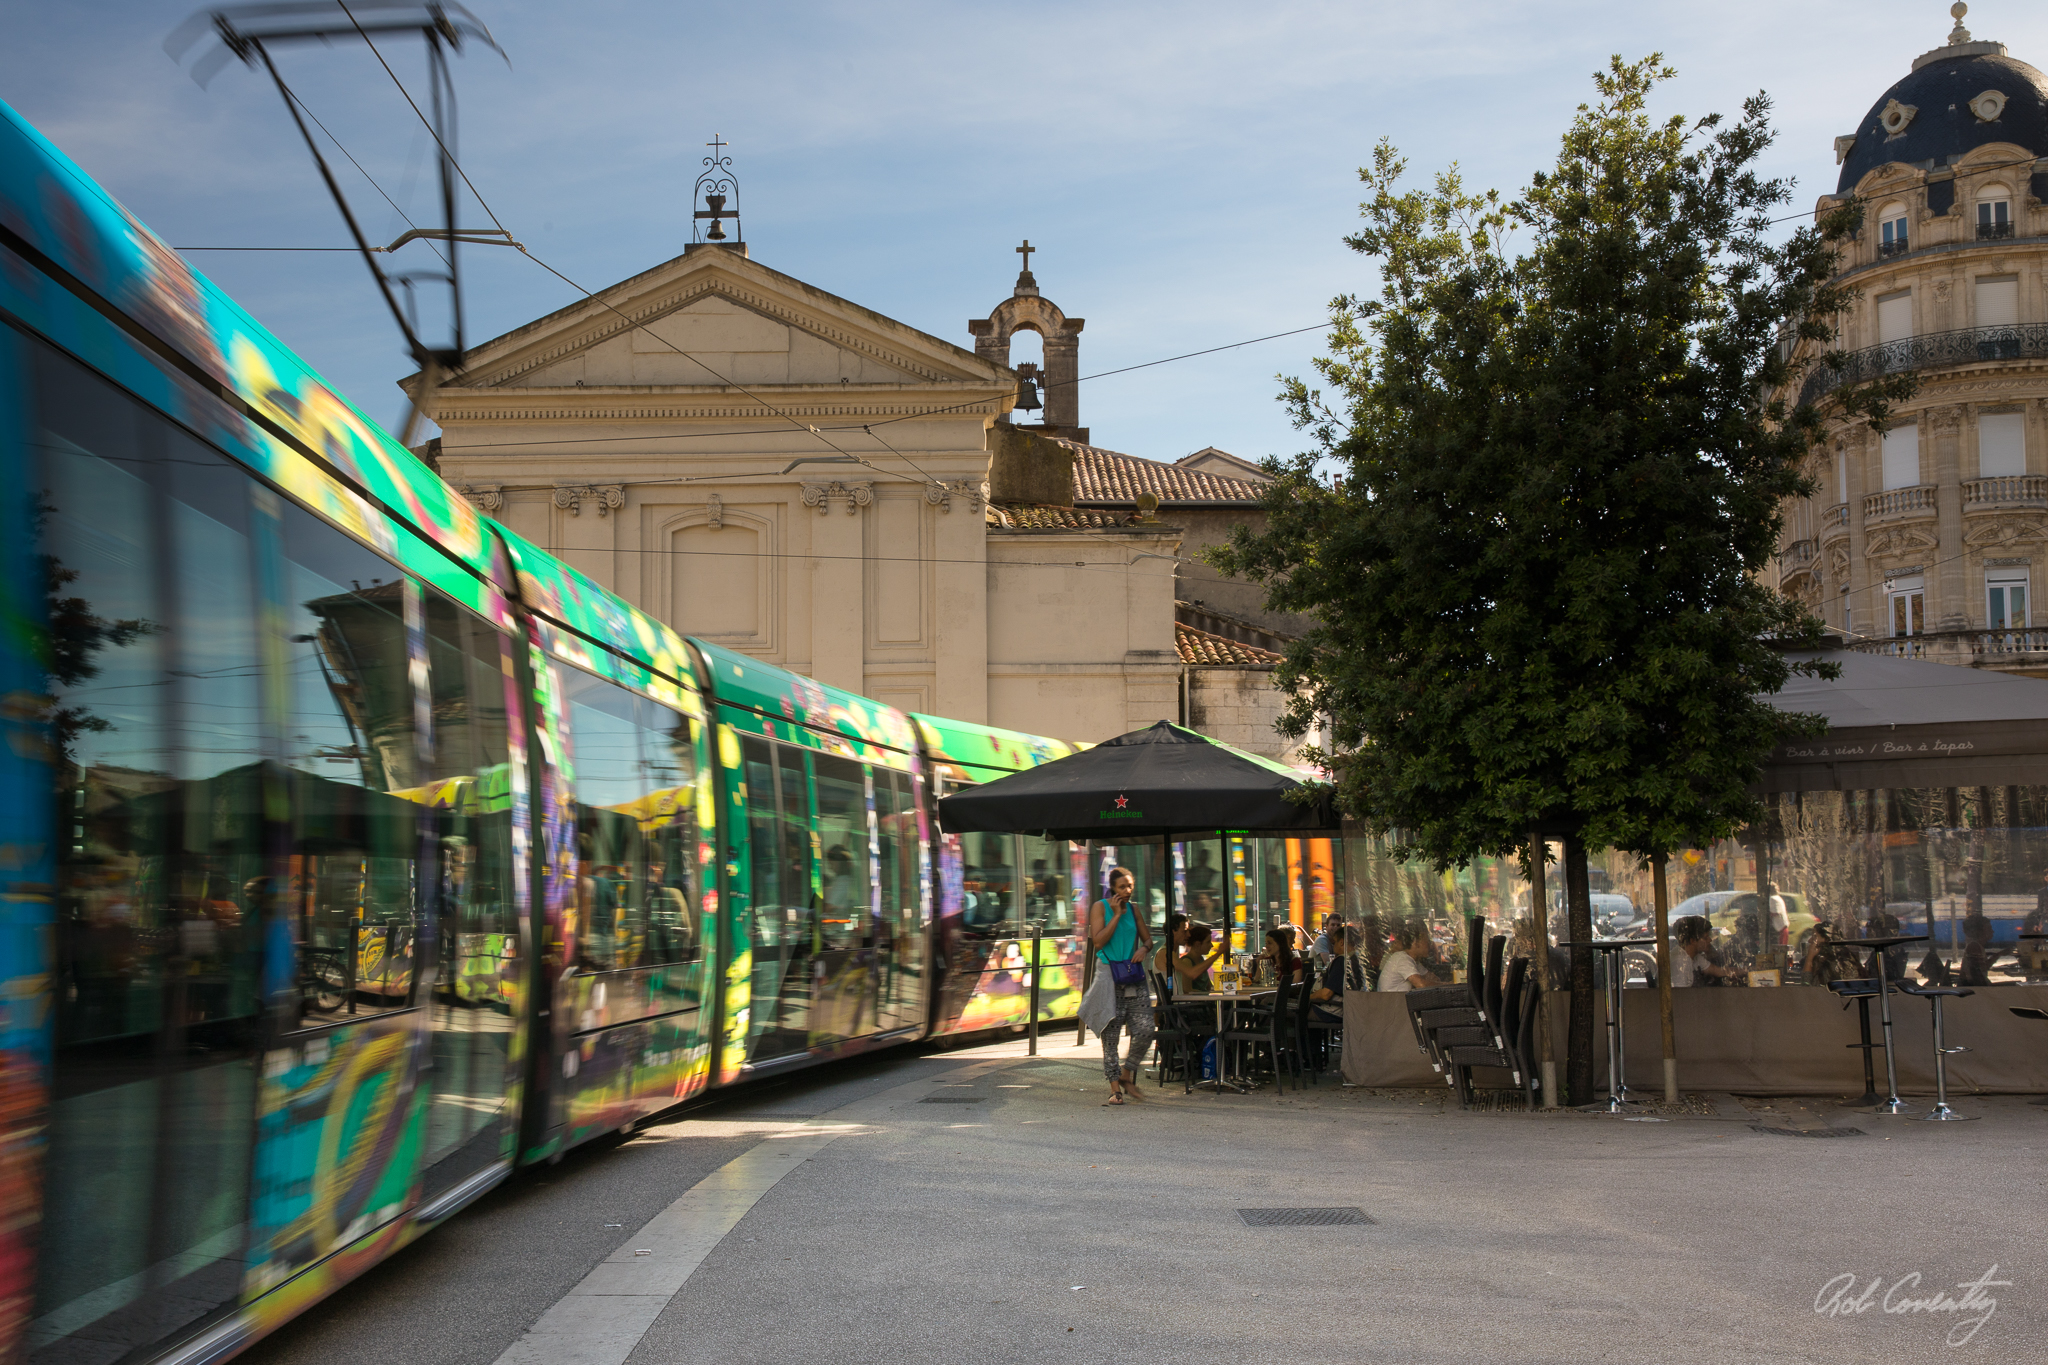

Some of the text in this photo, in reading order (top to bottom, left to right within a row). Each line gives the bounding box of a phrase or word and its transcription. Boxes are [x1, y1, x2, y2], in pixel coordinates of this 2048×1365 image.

[1786, 746, 1815, 758] Bar
[1819, 746, 1829, 756] à
[1834, 745, 1865, 756] vins
[1883, 742, 1913, 753] Bar
[1917, 742, 1928, 751] à
[1932, 739, 1974, 756] tapas
[1100, 809, 1143, 819] Heineken
